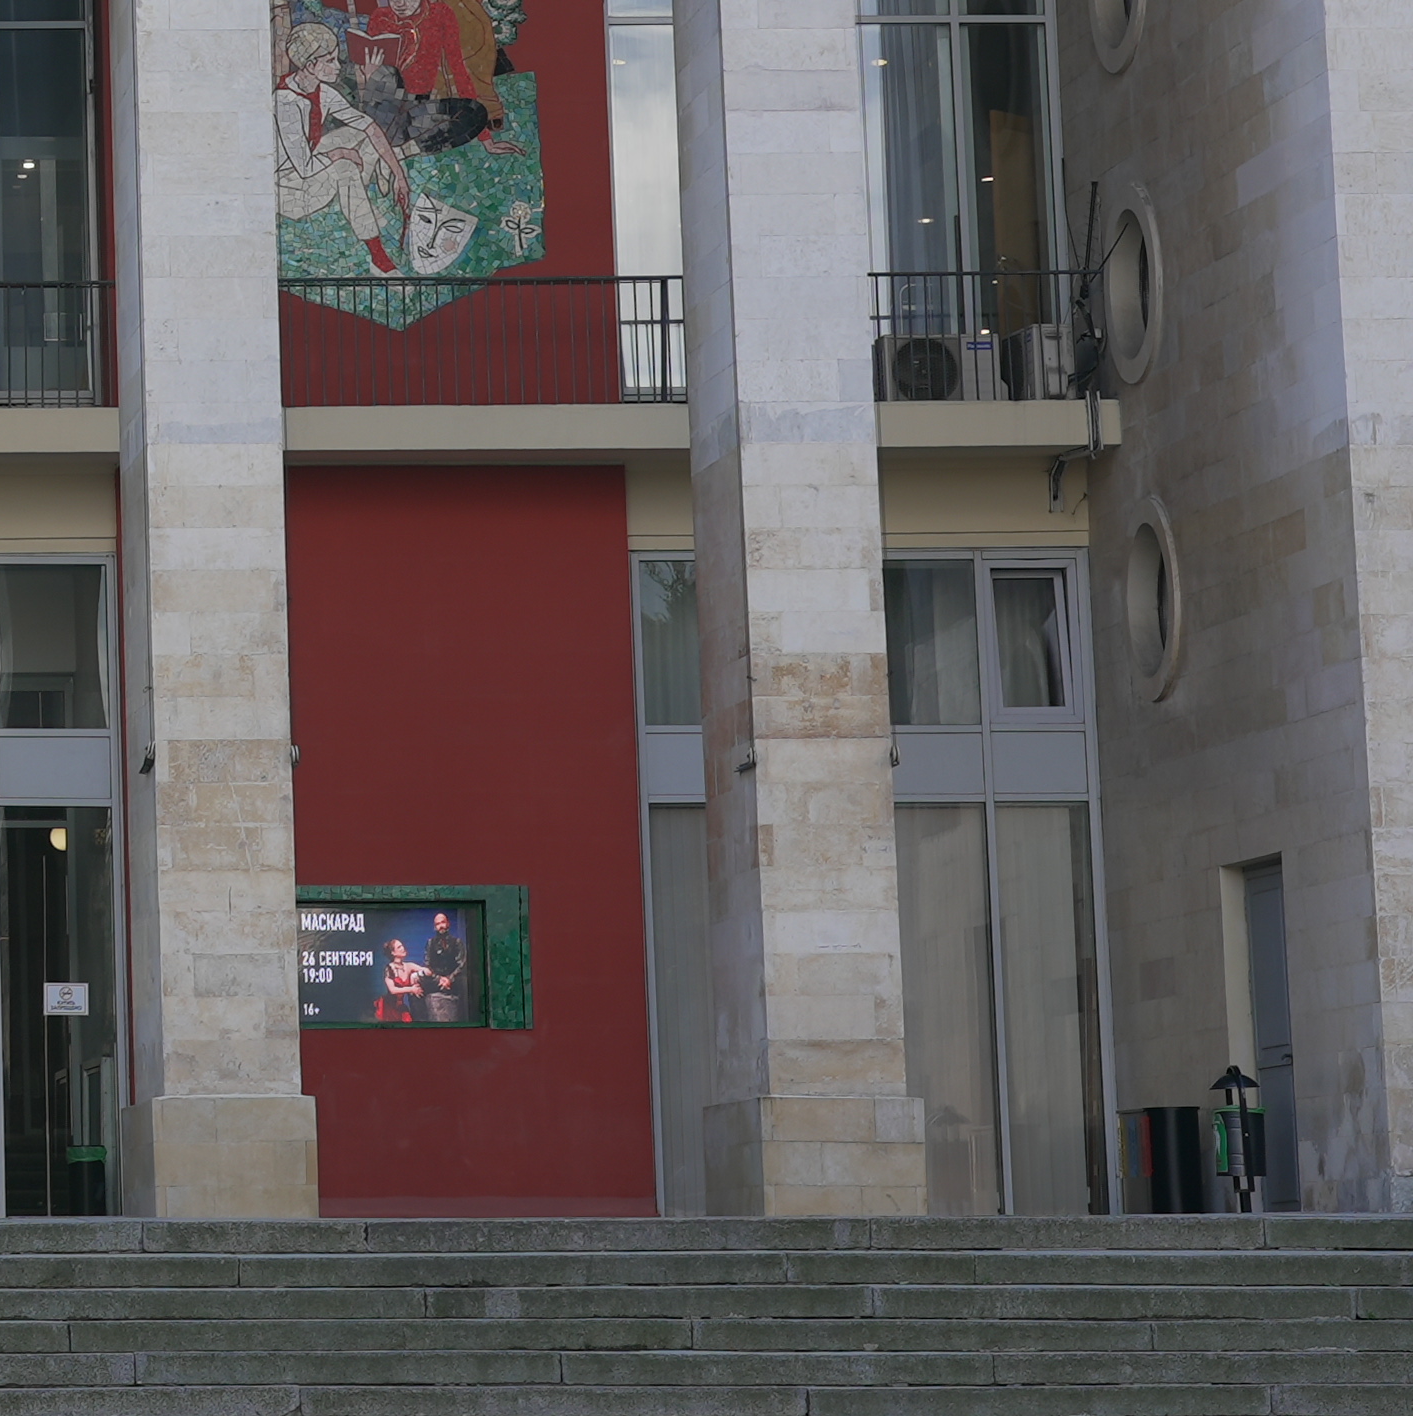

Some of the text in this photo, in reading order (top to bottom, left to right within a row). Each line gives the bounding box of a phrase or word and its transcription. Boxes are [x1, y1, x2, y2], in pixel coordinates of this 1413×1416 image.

[301, 913, 365, 933] МАСКАРАД
[302, 951, 373, 966] 26 СЕНТЯБРЯ
[303, 968, 333, 983] 19:00
[303, 1003, 320, 1015] 16+
